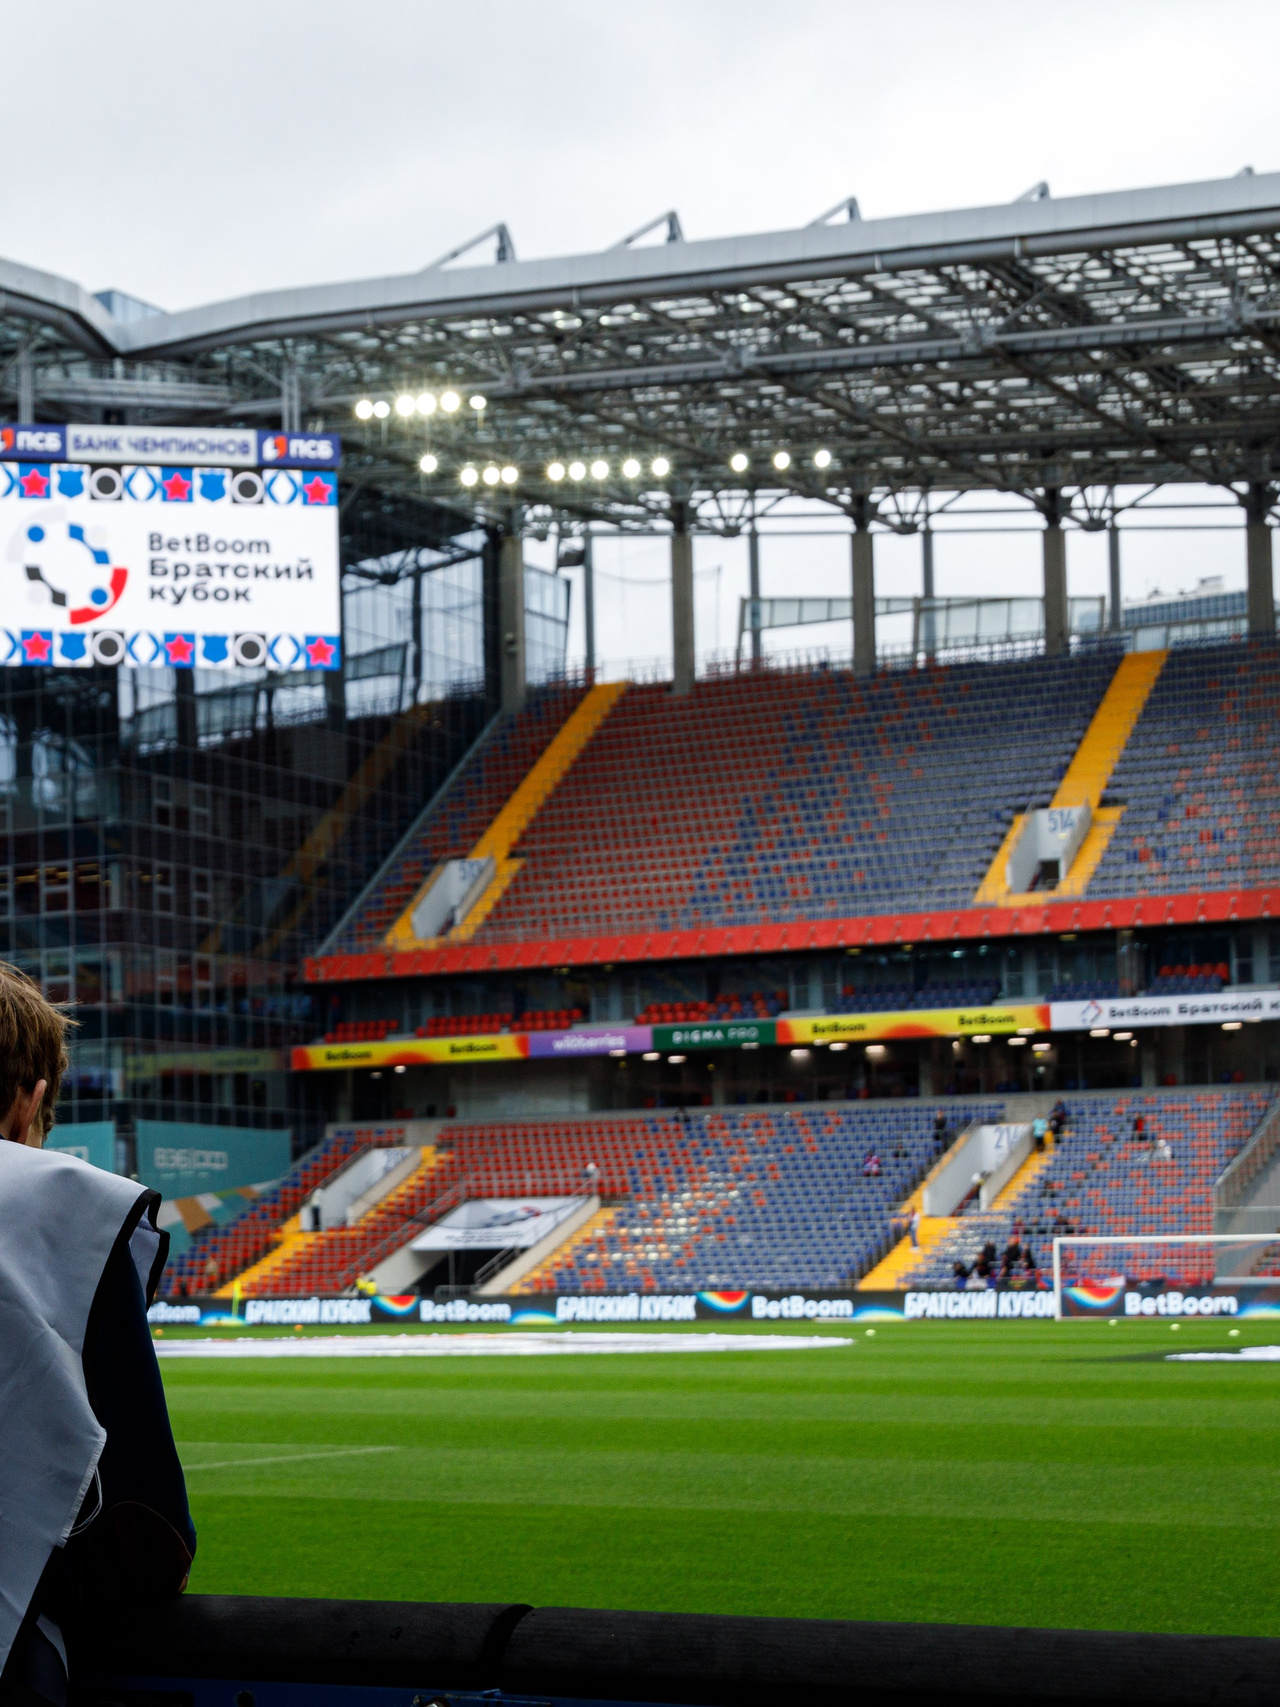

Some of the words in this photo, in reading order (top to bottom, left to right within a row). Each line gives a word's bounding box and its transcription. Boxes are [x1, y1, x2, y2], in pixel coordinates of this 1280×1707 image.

[16, 431, 62, 453] ПСБ
[73, 435, 122, 451] БАНК
[128, 437, 250, 454] ЧЕМПИОНОВ
[289, 439, 334, 460] ПСБ
[149, 533, 271, 553] BetBoom
[150, 558, 313, 581] Братский
[150, 582, 251, 605] кубок
[1109, 1006, 1170, 1018] BetBoom
[1178, 998, 1263, 1016] Братский
[812, 1022, 867, 1035] BetBoom
[958, 1014, 1017, 1027] BetBoom
[553, 1033, 626, 1050] wildberries
[672, 1030, 725, 1044] DIGMA
[727, 1026, 760, 1040] PRO
[245, 1298, 319, 1324] БРАТСКИЙ
[321, 1299, 372, 1324] КУБОК
[420, 1299, 511, 1322] BetBoom
[556, 1293, 638, 1321] БРАТСКИЙ
[639, 1295, 697, 1321] КУБОК
[751, 1295, 854, 1318] BetBoom
[904, 1289, 997, 1318] БРАТСКИЙ
[1125, 1291, 1238, 1316] BetBoom
